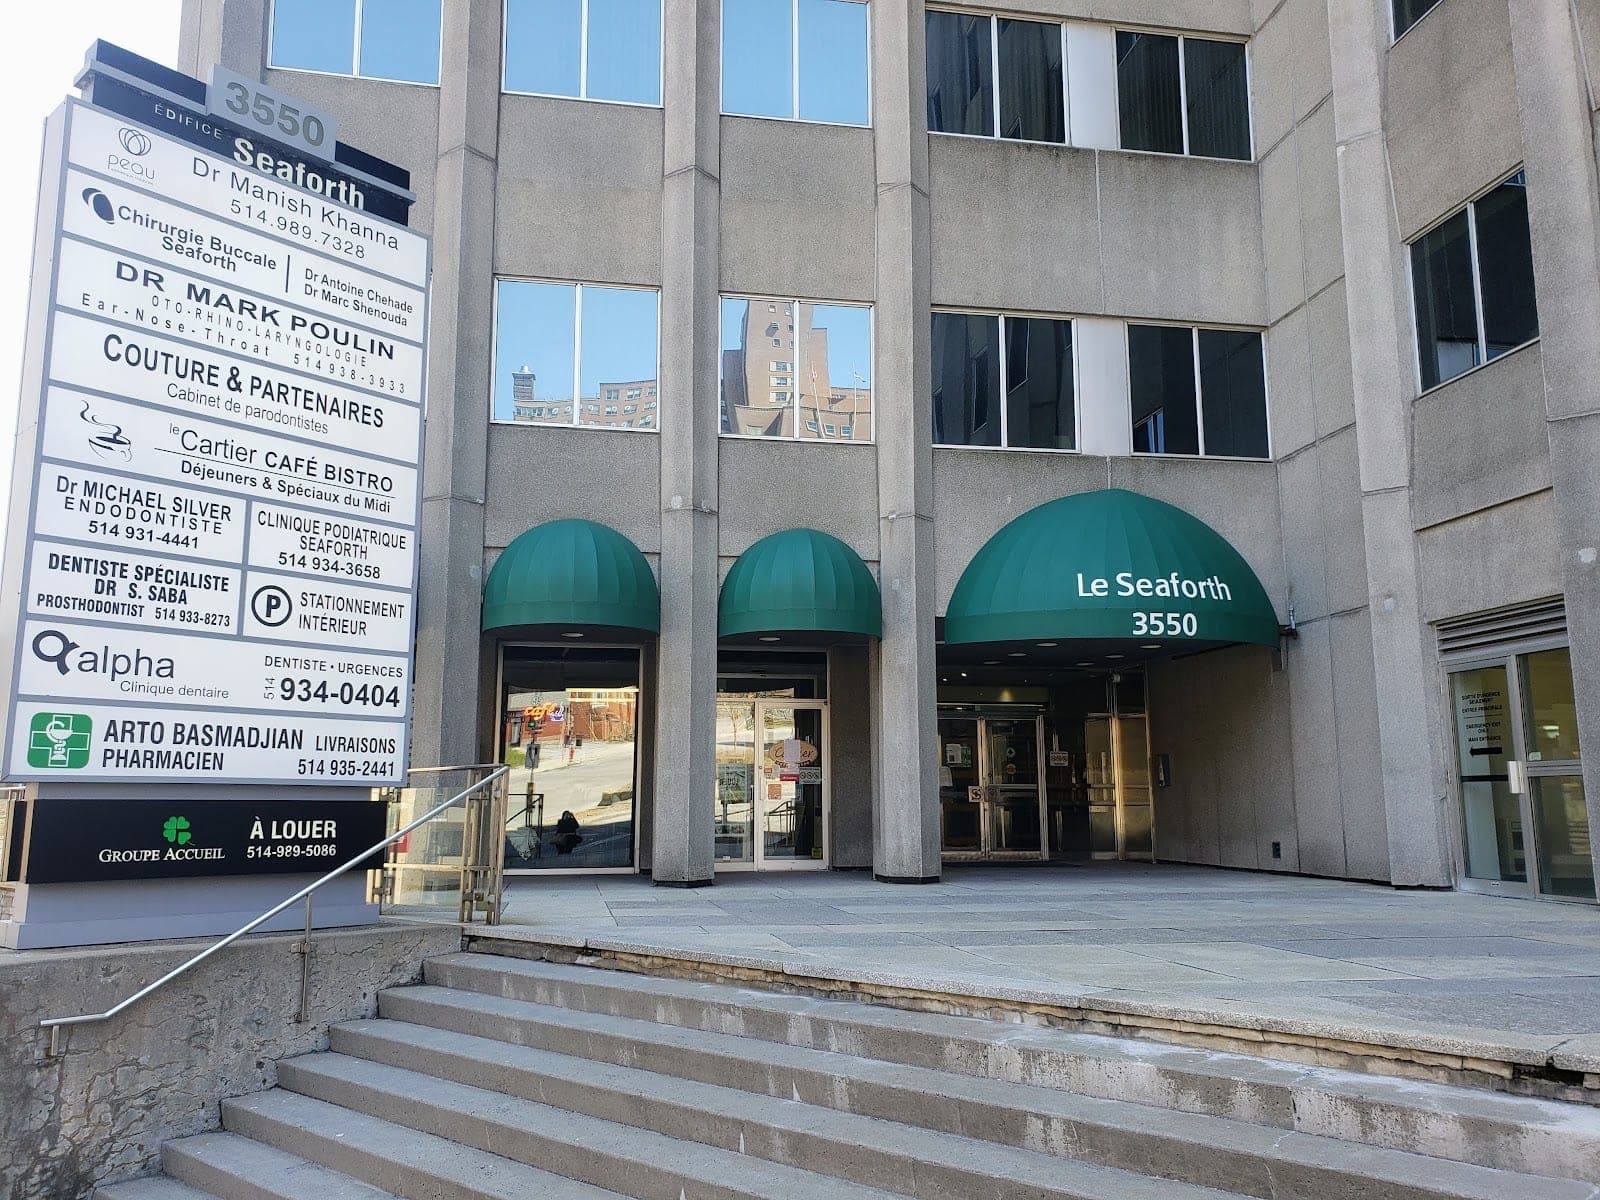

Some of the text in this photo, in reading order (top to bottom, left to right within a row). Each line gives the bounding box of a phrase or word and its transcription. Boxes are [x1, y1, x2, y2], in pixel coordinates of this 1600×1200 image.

[154, 102, 223, 140] ÉDIFICE
[225, 81, 325, 147] 3550
[107, 154, 155, 180] peau
[233, 137, 366, 211] Seaforth
[193, 156, 399, 251] Dr Manish Khanna
[117, 205, 277, 271] Chirurgie Buccale
[230, 199, 366, 260] 514.989.7328
[161, 235, 237, 273] Seaforth
[116, 260, 396, 360] DR MARK POULIN
[304, 268, 414, 314] Dr Antoine Chehade
[304, 284, 408, 328] Dr Marc Shenouda
[82, 292, 406, 395] Ear-Nose-Throat 514 938-3933
[151, 295, 367, 368] OTO-RHINO-LARYNGOLOGIE
[103, 333, 385, 429] COUTURE & PARTENAIRES
[167, 382, 329, 435] Cabinet de parodontistes
[169, 423, 393, 493] le Cartier CAFÉ BISTRO
[56, 475, 232, 522] Dr MICHAEL SILVER
[181, 460, 391, 514] Déjeuners & Spéciaux du Midi
[63, 496, 223, 535] ENDODONTISTE
[257, 510, 408, 550] CLINIQUE PODIATRIQUE
[88, 520, 200, 550] 514 931-4441
[299, 535, 369, 560] SEAFORTH
[48, 552, 230, 593] DENTISTE SPÉCIALISTE
[278, 551, 382, 580] 514 934-3658
[94, 578, 188, 605] DR S. SABA
[265, 593, 281, 618] P
[299, 591, 405, 620] STATIONNEMENT
[1077, 572, 1232, 601] Le Seaforth
[36, 593, 231, 628] PROSTHODONTIST 514 933-8273
[298, 612, 368, 637] INTÉRIEUR
[1132, 611, 1198, 637] 3550
[264, 655, 403, 679] DENTISTE URGENCES
[119, 680, 230, 700] Clinique dentaire
[263, 676, 401, 708] 514 934-0404
[103, 719, 397, 755] ARTO BASMADJIAN LIVRAISONS
[101, 748, 395, 777] PHARMACIEN 514 935-2441
[249, 815, 337, 841] À LOUER
[98, 847, 226, 864] GROUPE ACCUEIL
[246, 844, 337, 860] 514-989-5086
